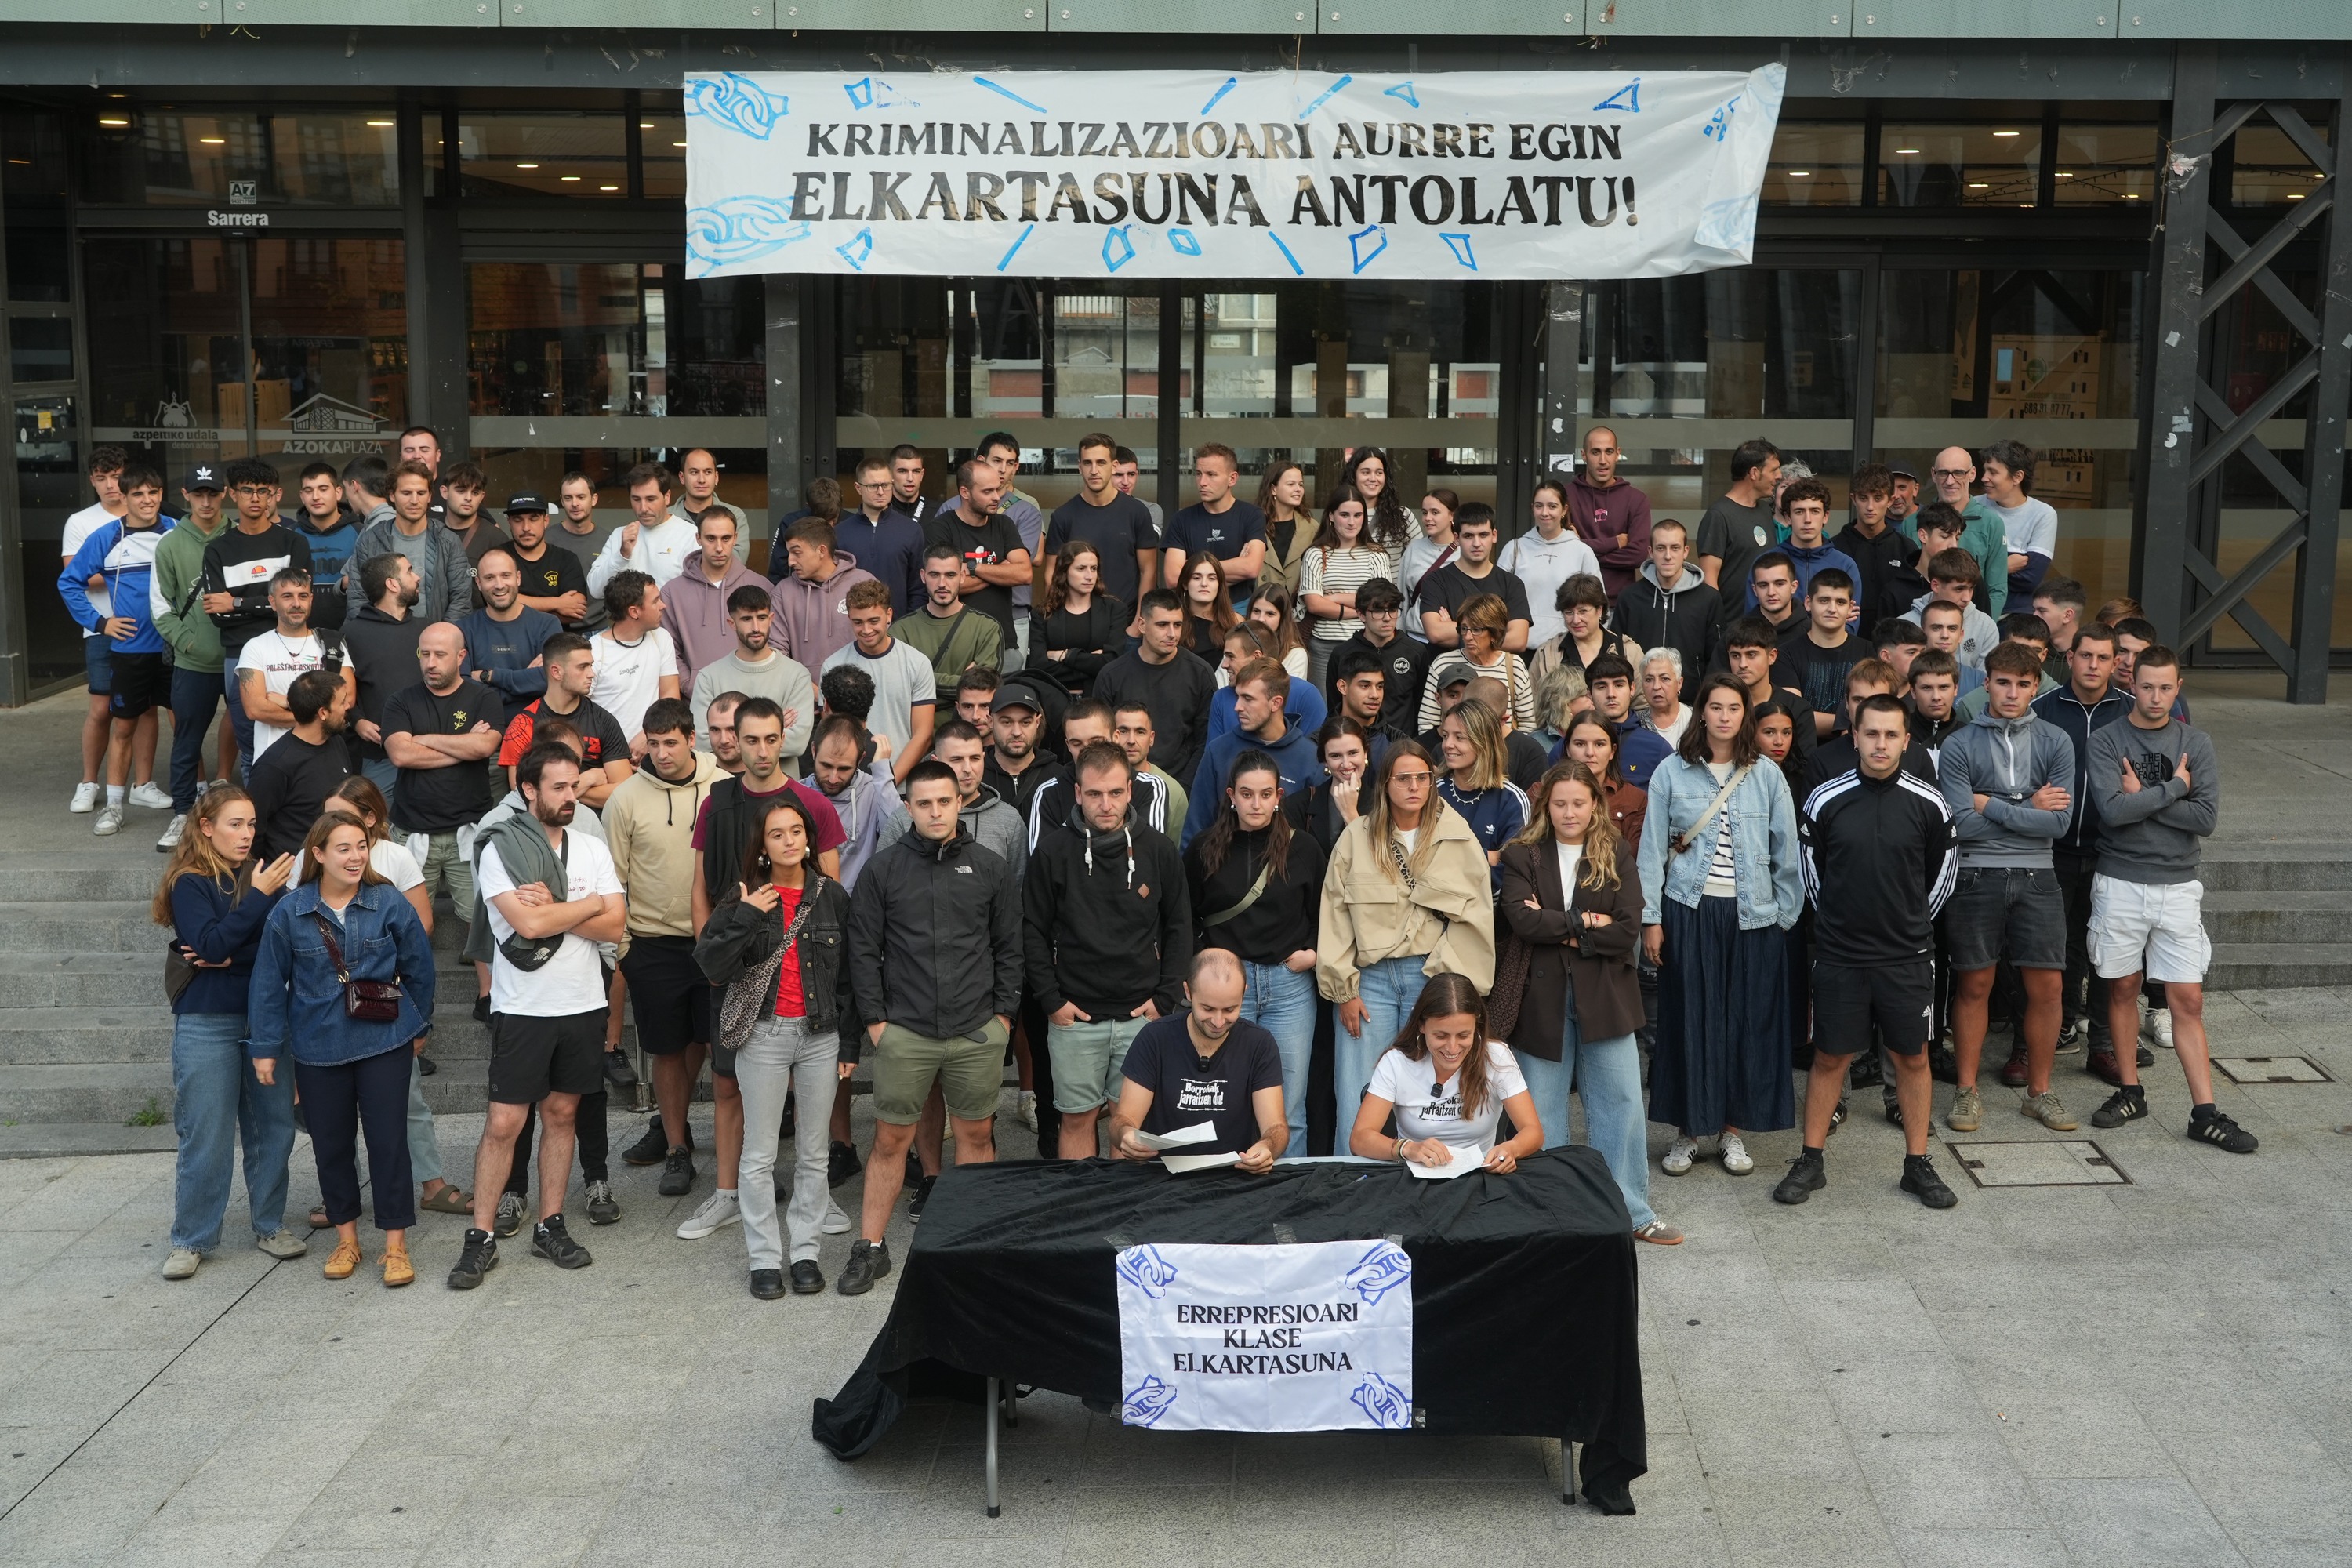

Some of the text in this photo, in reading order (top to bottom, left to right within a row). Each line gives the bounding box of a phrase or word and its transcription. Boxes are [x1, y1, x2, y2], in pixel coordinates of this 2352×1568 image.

[806, 121, 1623, 162] KRIMINALIZAZIOARI AURRE EGIN
[789, 170, 1639, 227] ELKARTASUNA ANTOLATU!
[208, 209, 269, 227] Sarrera
[282, 441, 383, 454] AZOKAPLAZA
[2141, 753, 2160, 762] THE
[2138, 771, 2160, 781] FACE
[1185, 1082, 1220, 1094] Borrokak
[1177, 1089, 1224, 1107] jarraitzen du!
[1177, 1302, 1359, 1325] ERREPRESIOARI
[1223, 1327, 1302, 1349] KLASE
[1174, 1352, 1353, 1374] ELKARTASUNA
